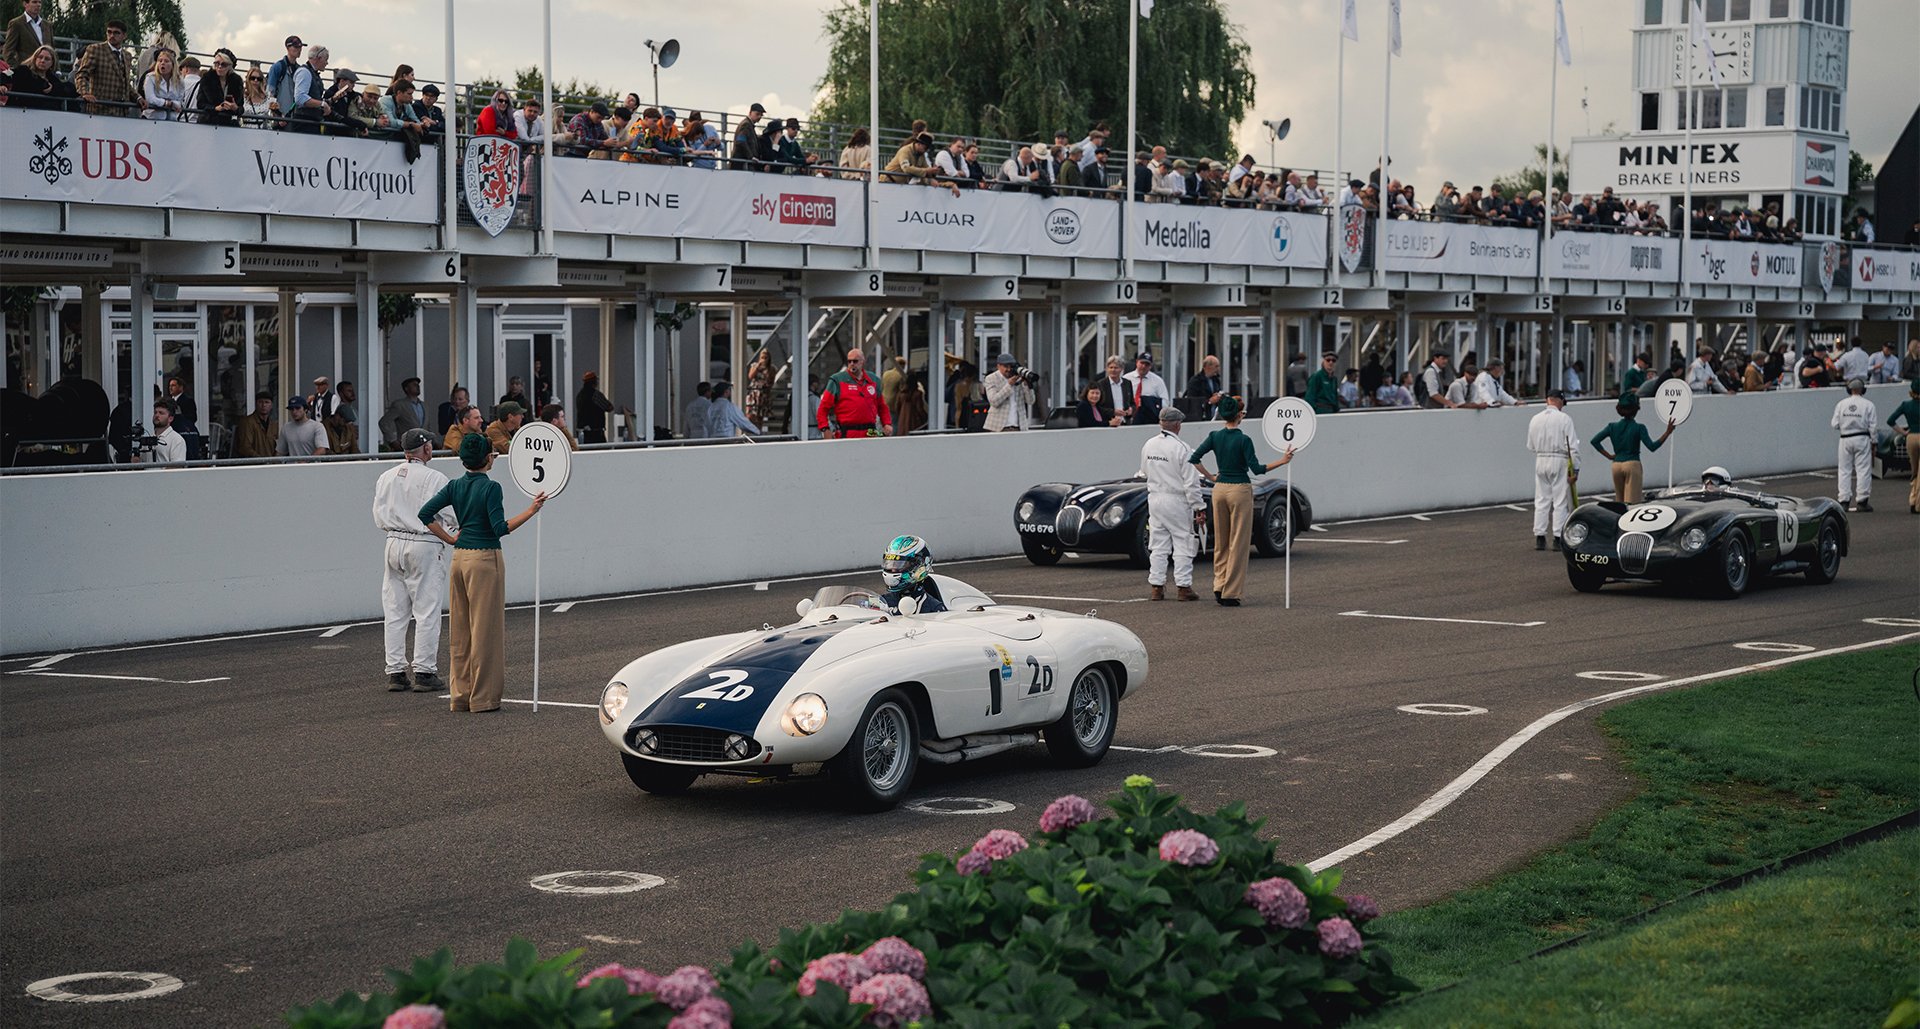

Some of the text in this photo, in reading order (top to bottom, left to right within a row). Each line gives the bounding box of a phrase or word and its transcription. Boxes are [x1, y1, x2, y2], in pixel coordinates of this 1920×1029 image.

[1676, 34, 1684, 80] ROLEX
[1743, 31, 1751, 77] ROLEX
[79, 137, 153, 182] UBS
[1619, 143, 1740, 166] MINTEX
[1807, 156, 1835, 172] CHAMPION
[251, 149, 416, 200] Veuve Clicquot
[1618, 170, 1741, 185] BRAKE LINERS
[580, 188, 679, 209] ALPINE
[752, 193, 834, 222] sky cinema
[897, 210, 975, 227] JAGUAR
[1052, 216, 1070, 225] LAND
[1053, 226, 1075, 235] ROVER
[1145, 219, 1211, 249] Medallia
[23, 250, 83, 261] ORGANISATION
[224, 247, 235, 269] 5
[1513, 244, 1531, 259] Cars
[242, 257, 270, 266] MARTIN
[273, 258, 304, 267] LAGONDA
[444, 257, 456, 278] 6
[1709, 257, 1725, 280] bgc
[1766, 255, 1796, 275] MOTUL
[1876, 263, 1889, 276] HSBC
[717, 268, 728, 286] 7
[870, 274, 879, 291] 8
[1005, 279, 1015, 296] 9
[1116, 284, 1134, 299] 10
[1228, 288, 1242, 302] 11
[1324, 290, 1340, 304] 12
[1455, 294, 1470, 308] 14
[1535, 297, 1550, 310] 15
[1608, 299, 1622, 311] 16
[1675, 300, 1689, 312] 17
[1739, 302, 1753, 313] 18
[1799, 303, 1812, 315] 19
[1896, 305, 1911, 317] 20
[1665, 389, 1683, 397] ROW
[1277, 409, 1302, 418] ROW
[1669, 400, 1677, 415] 7
[1282, 422, 1295, 442] 6
[525, 436, 554, 452] ROW
[531, 456, 545, 483] 5
[1629, 507, 1663, 522] 18
[1020, 523, 1054, 534] PUG 676
[1782, 512, 1794, 543] 18
[1575, 552, 1609, 565] LSF 420
[1026, 654, 1053, 695] 2D
[678, 669, 754, 702] 2D
